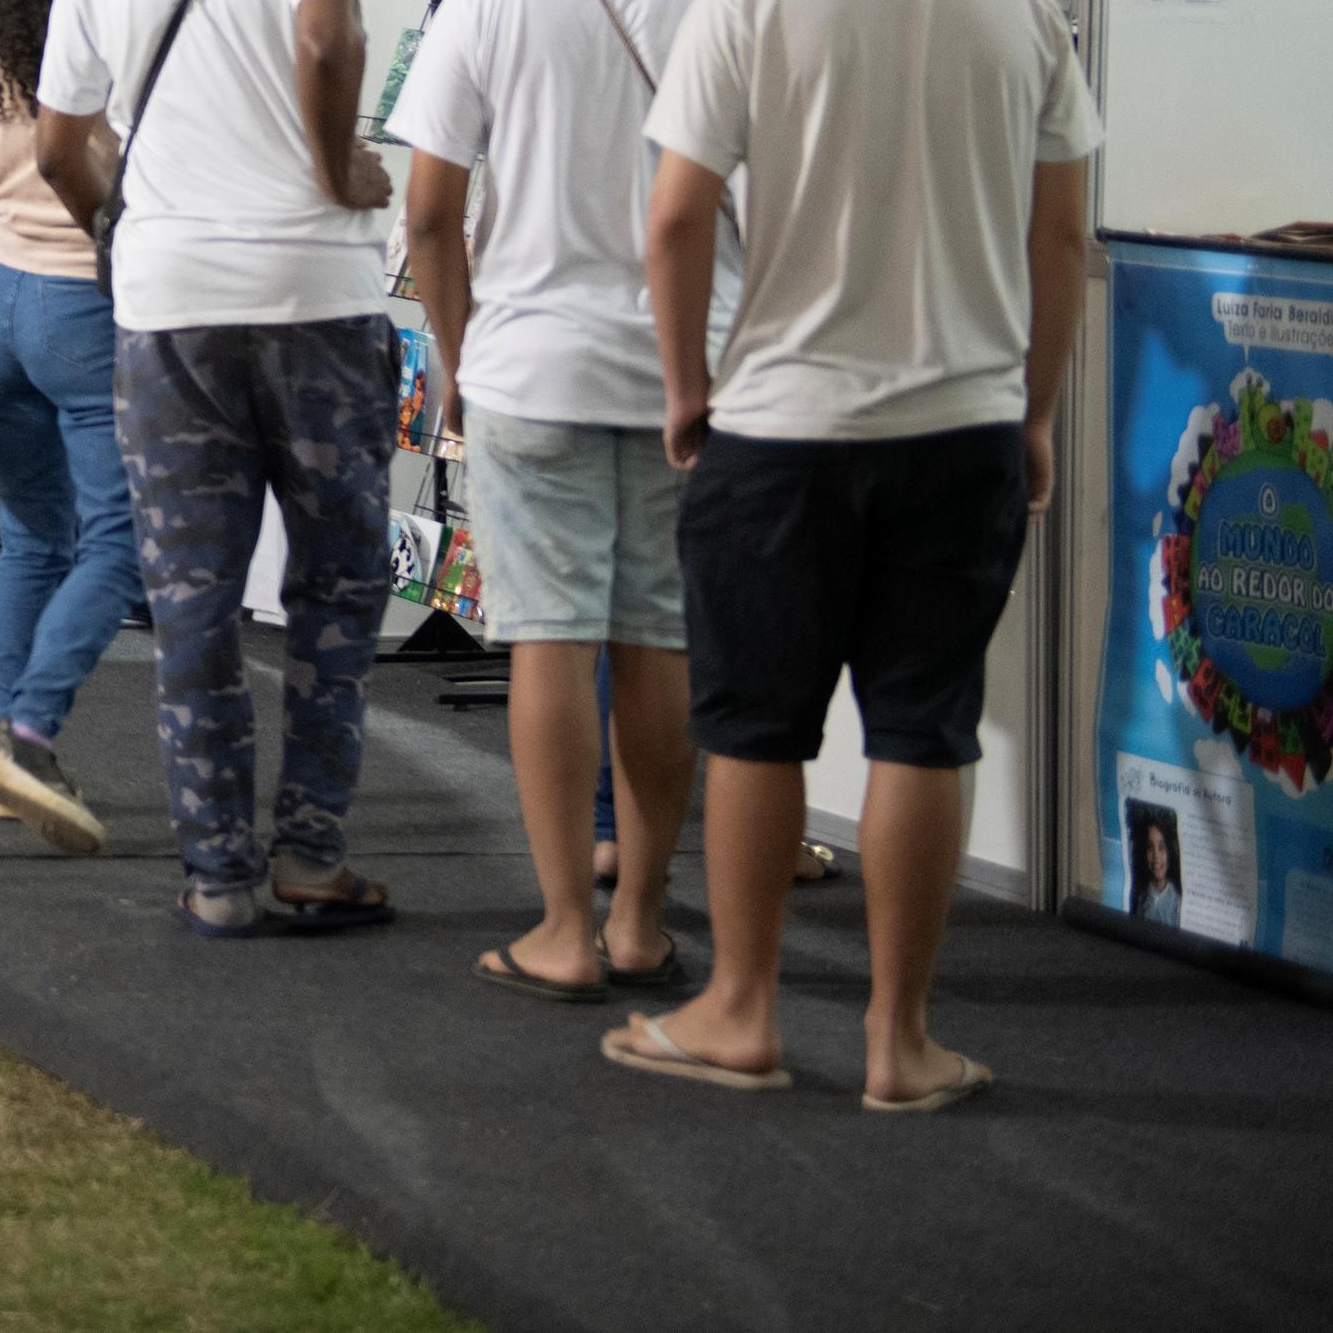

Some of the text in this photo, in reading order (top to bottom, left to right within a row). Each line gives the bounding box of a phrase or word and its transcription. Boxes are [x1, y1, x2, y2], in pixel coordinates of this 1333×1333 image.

[1261, 486, 1278, 515] O
[1219, 520, 1316, 571] MUNDO
[1198, 564, 1223, 592] AO
[1233, 567, 1306, 608] REDOR
[1208, 604, 1326, 657] CARACOL
